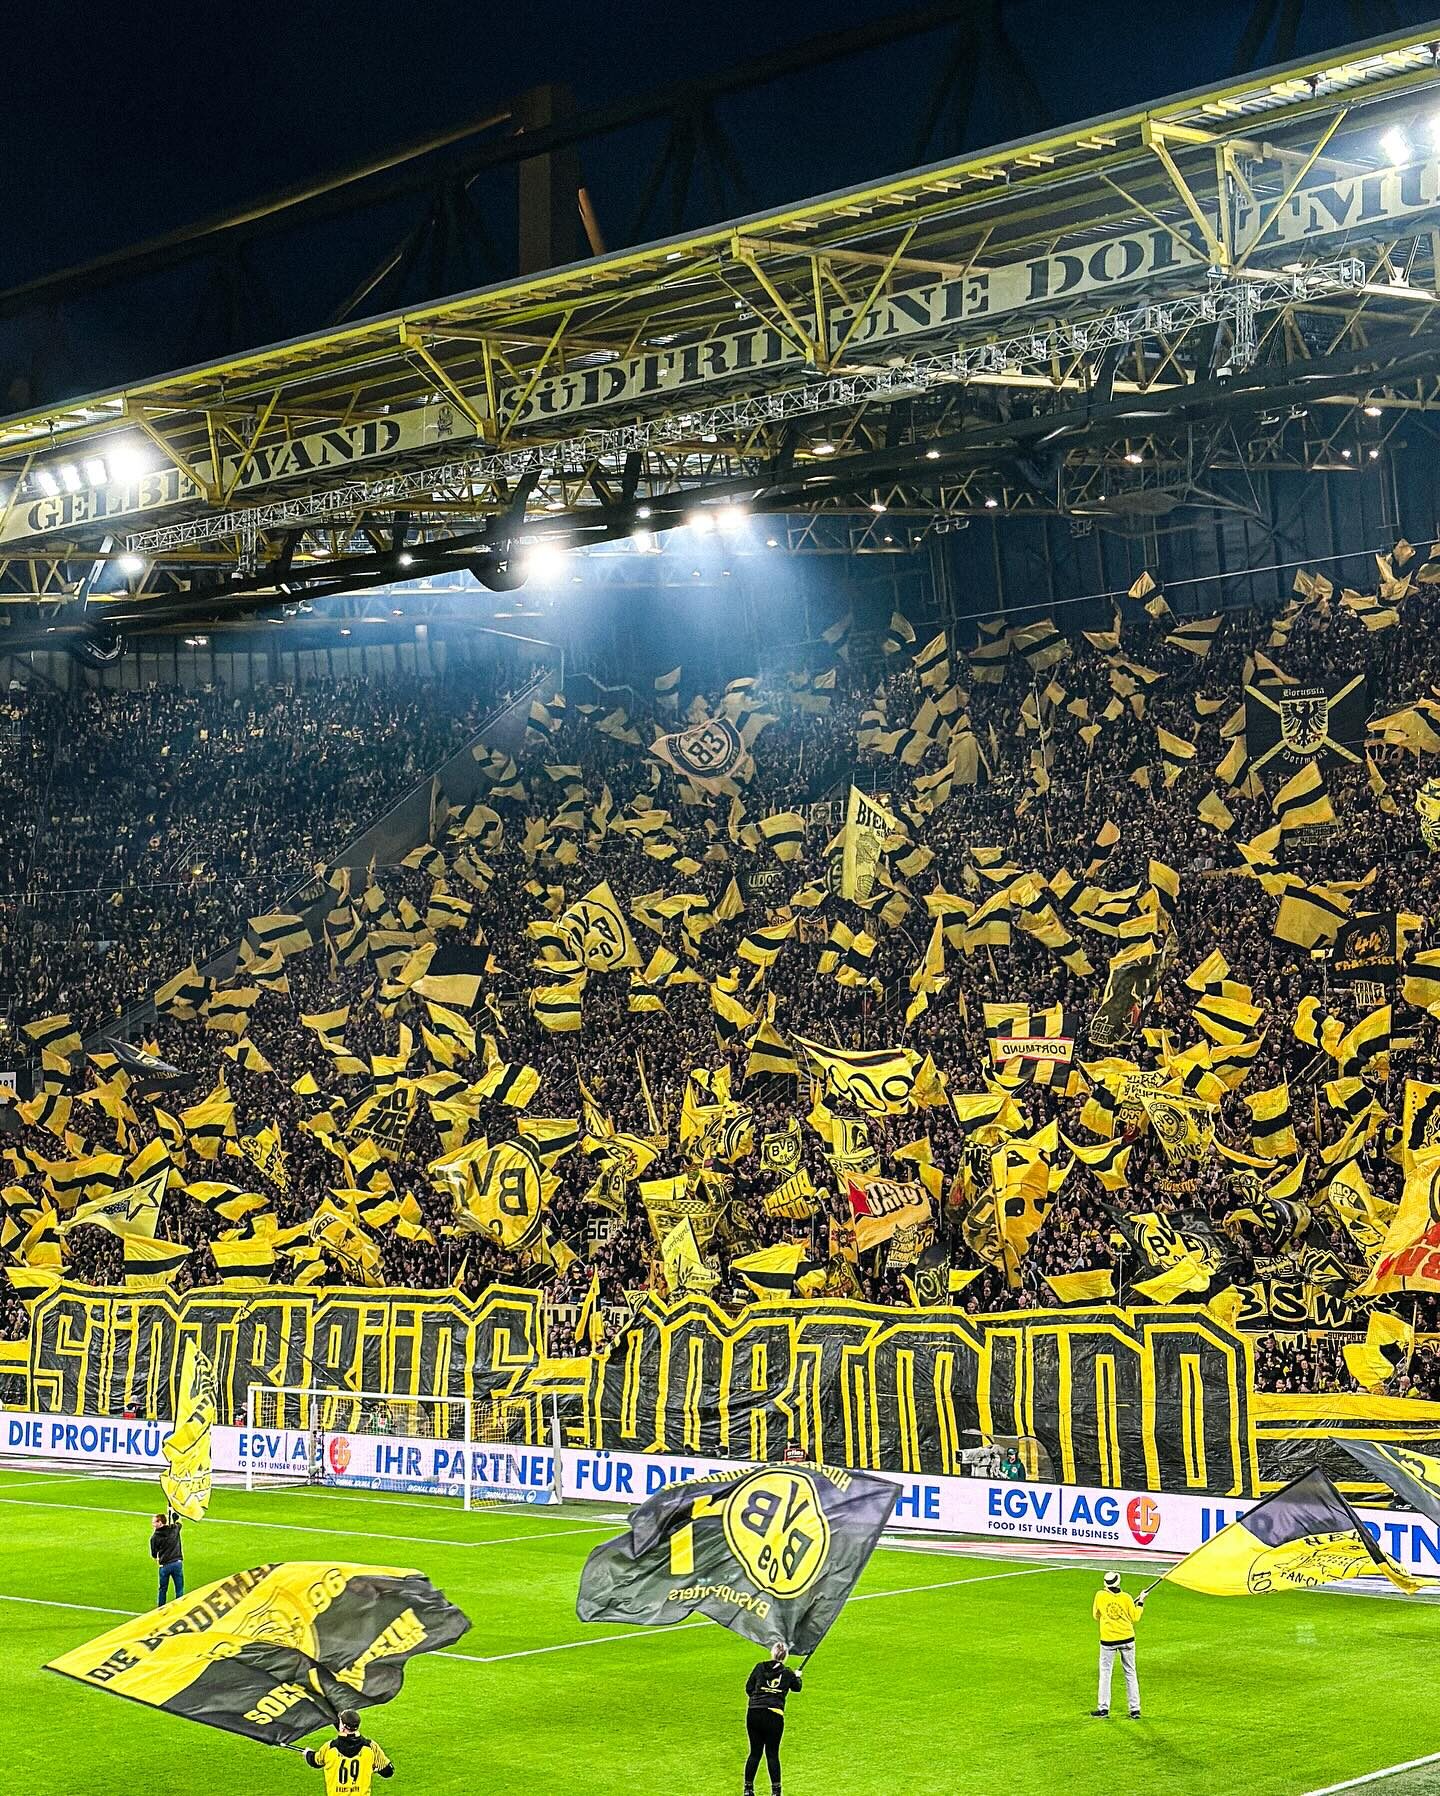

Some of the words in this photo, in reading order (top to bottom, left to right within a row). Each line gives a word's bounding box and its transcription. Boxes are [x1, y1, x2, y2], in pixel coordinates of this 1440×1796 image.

[27, 466, 198, 532] GELBE
[230, 418, 401, 486] WAND
[1283, 687, 1325, 697] Borussia
[688, 730, 726, 765] 83
[1283, 748, 1329, 765] Dortmund
[771, 1137, 795, 1157] BVB
[1147, 1213, 1201, 1257] BVB
[594, 1300, 1246, 1500] DORTMUND
[9, 1420, 43, 1448] DIE
[238, 1433, 281, 1459] EGV
[376, 1444, 422, 1476] IHR
[576, 1451, 634, 1494] FÜR
[988, 1487, 1052, 1520] EGV
[1069, 1494, 1120, 1527] AG
[988, 1521, 1016, 1531] FOOD
[1018, 1523, 1033, 1532] IST
[1036, 1525, 1068, 1536] UNSER
[1071, 1528, 1120, 1541] BUSINESS
[308, 1567, 347, 1613] 96
[86, 1653, 141, 1682] DIE
[338, 1758, 360, 1785] 69
